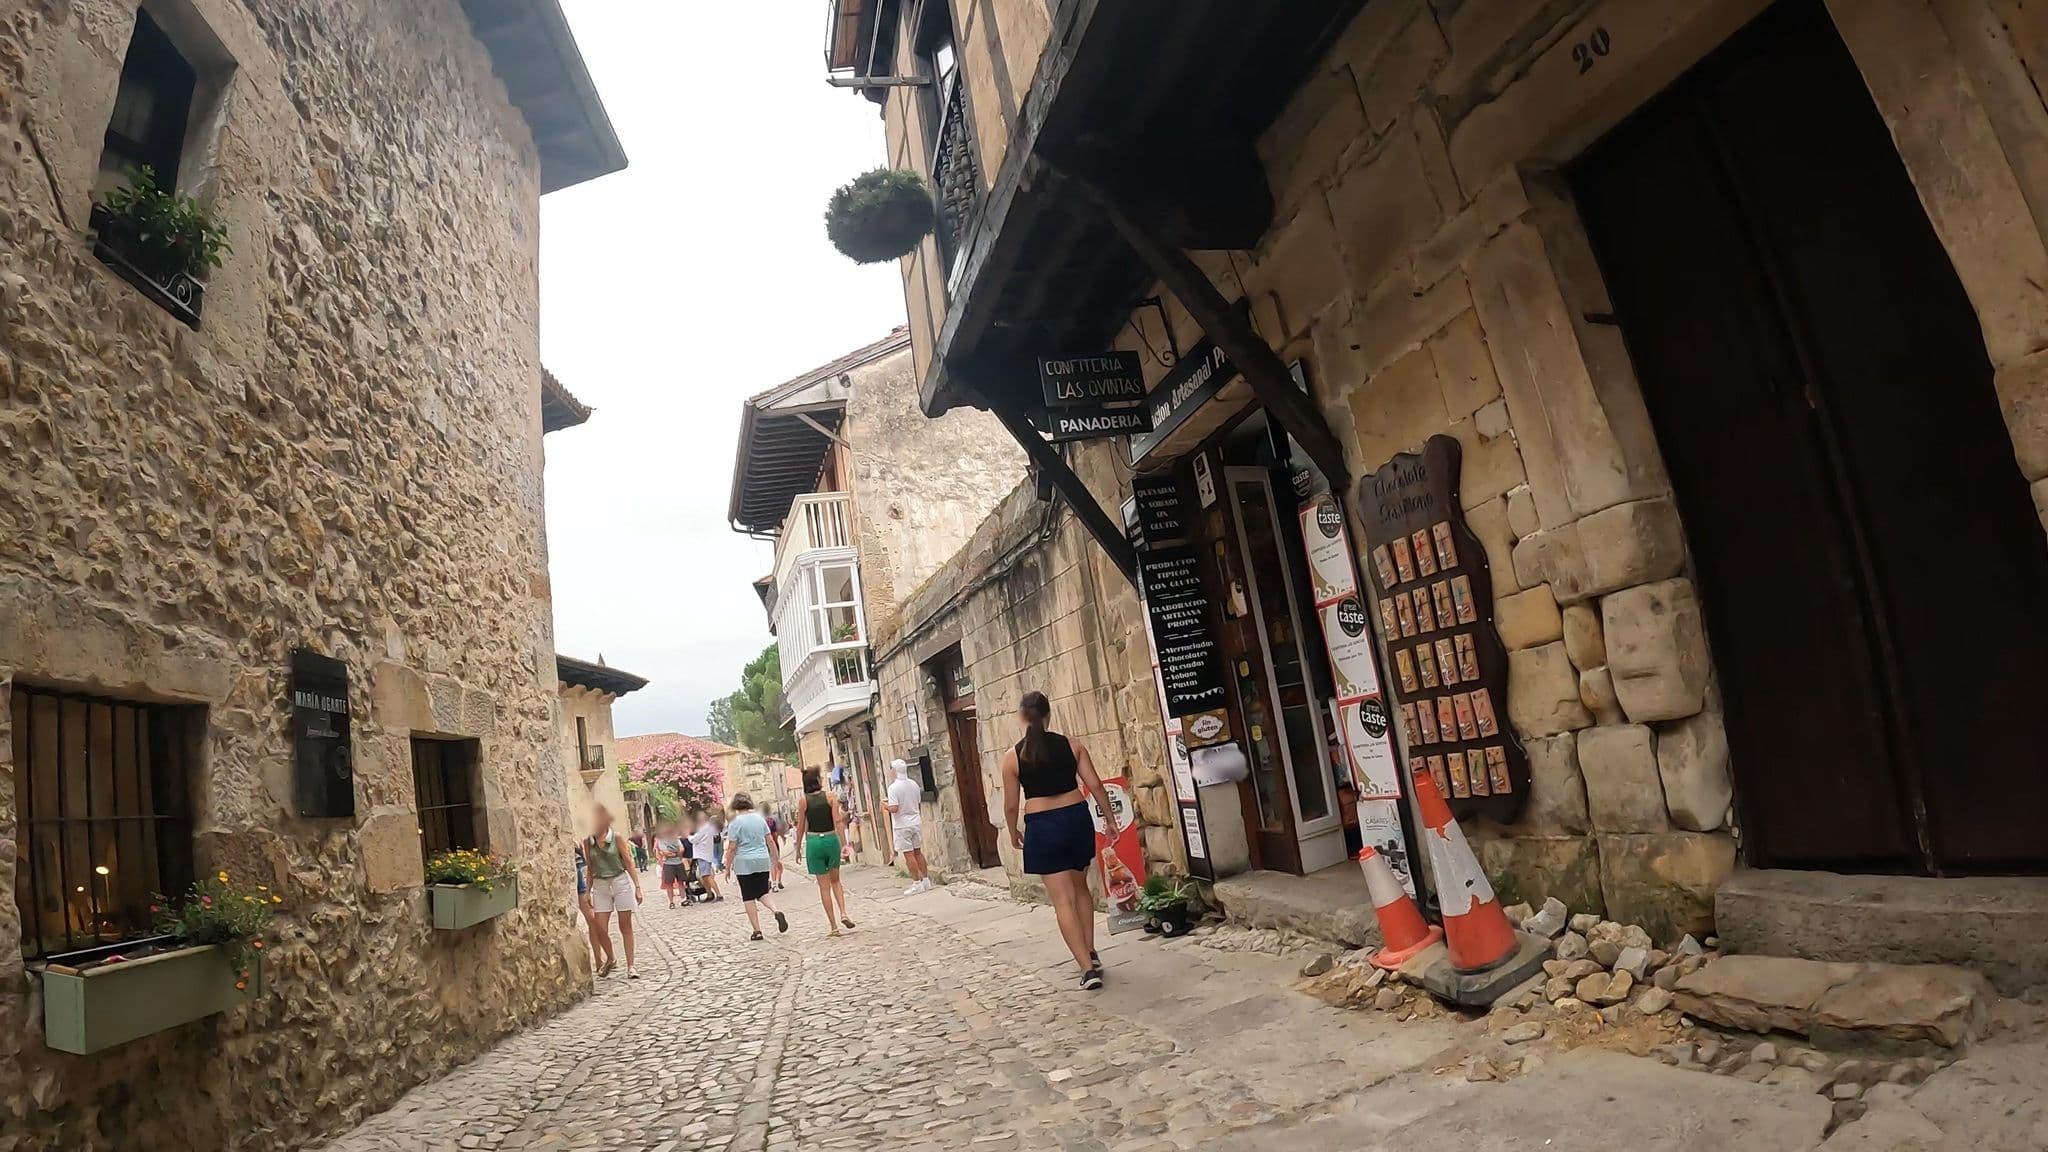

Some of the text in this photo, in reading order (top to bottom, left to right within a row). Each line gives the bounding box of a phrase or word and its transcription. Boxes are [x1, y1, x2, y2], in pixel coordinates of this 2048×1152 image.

[1572, 27, 1610, 76] 20
[1045, 358, 1123, 376] CONFITERIA
[1056, 381, 1084, 399] LAS
[1171, 356, 1212, 410] Artesanal
[1060, 414, 1143, 433] PANADERIA
[1292, 470, 1310, 486] taste
[1150, 520, 1179, 530] GLUTEN
[1318, 512, 1341, 524] taste
[1145, 558, 1197, 571] PRODUCTOS
[1157, 569, 1190, 579] TIPICOS
[1150, 577, 1201, 591] CON GLUTEN
[1161, 608, 1202, 620] ARTESANA
[1339, 611, 1365, 624] taste
[1167, 618, 1200, 629] PROPIA
[1165, 640, 1214, 654] Mermeladas
[1173, 679, 1198, 689] Pastas
[321, 696, 347, 714] UGARTE
[1360, 711, 1387, 727] taste
